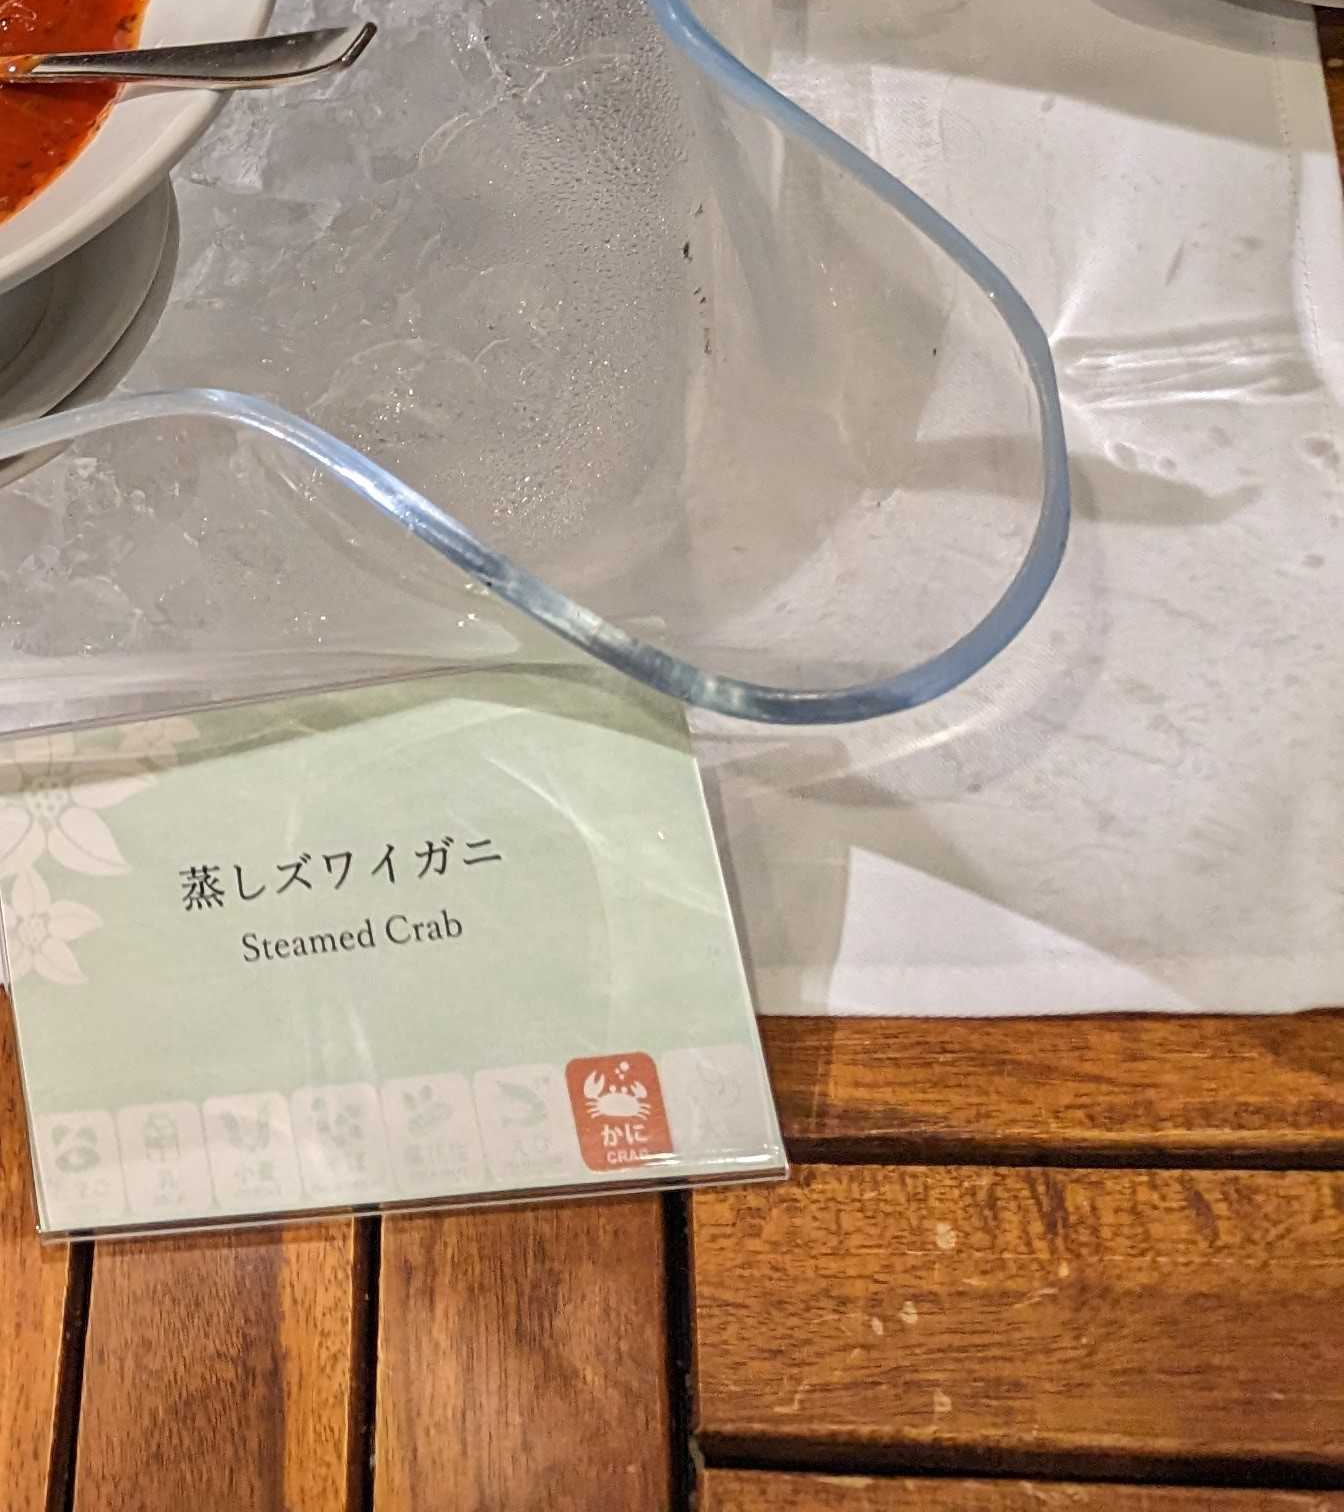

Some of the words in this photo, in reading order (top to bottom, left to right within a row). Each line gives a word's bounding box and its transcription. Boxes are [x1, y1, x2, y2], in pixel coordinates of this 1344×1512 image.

[178, 835, 503, 912] 蒸しズワイガニ
[241, 918, 376, 963] Steamed
[385, 909, 463, 945] Crab
[601, 1122, 649, 1146] かに
